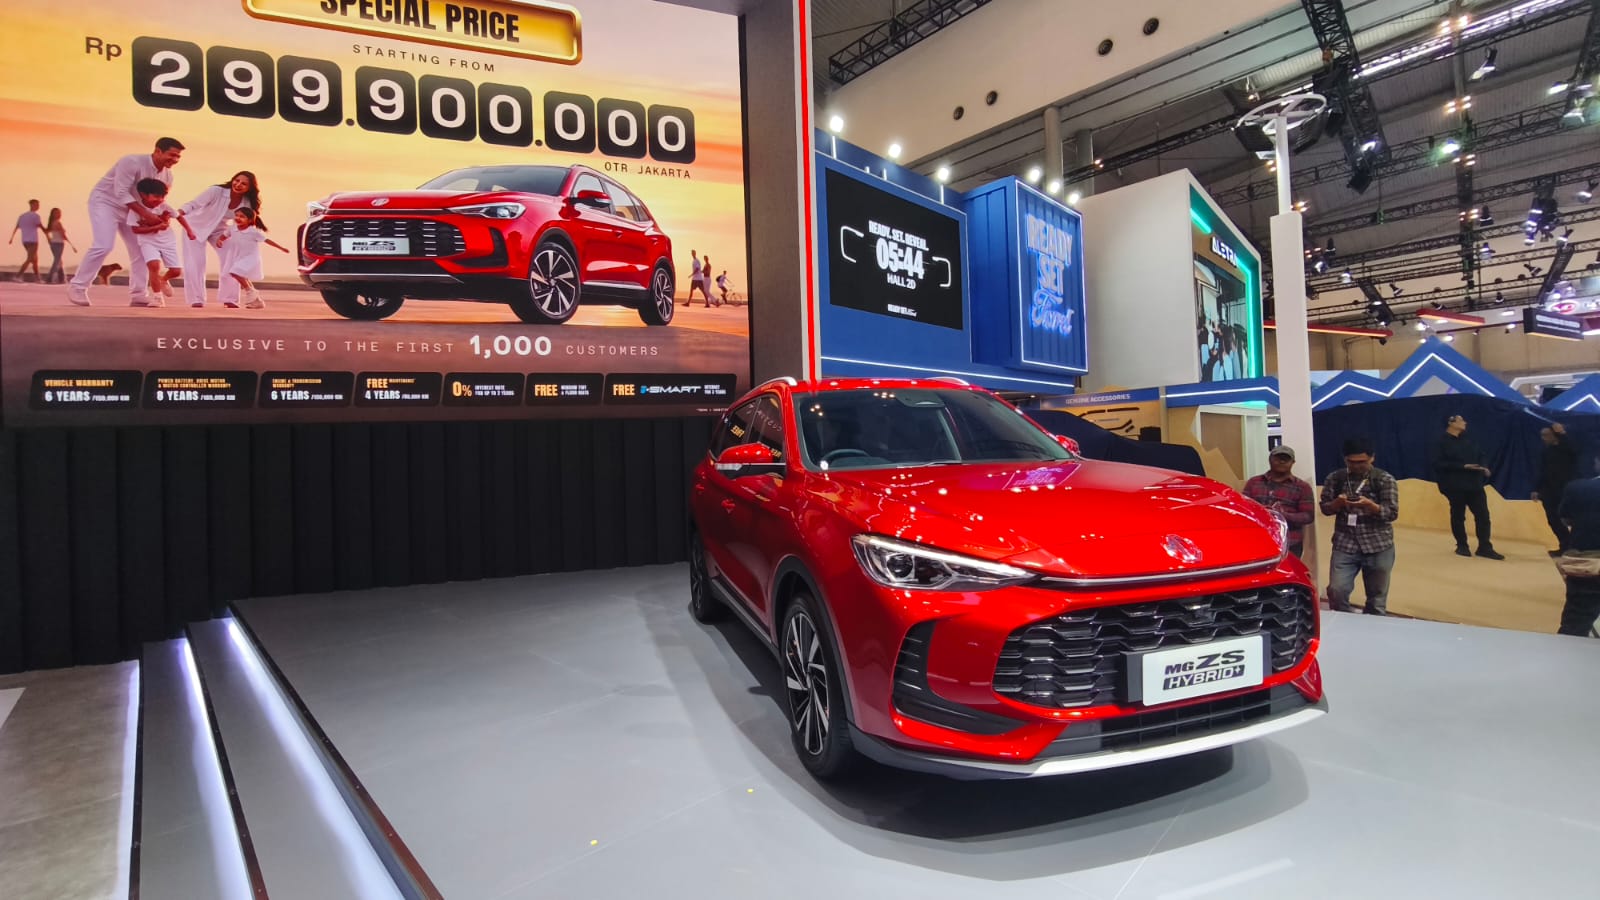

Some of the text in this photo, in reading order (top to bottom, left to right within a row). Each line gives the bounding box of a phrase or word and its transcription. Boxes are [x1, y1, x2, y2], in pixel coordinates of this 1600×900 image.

[446, 4, 520, 42] PRICE
[353, 44, 495, 72] STARTING FROM
[85, 37, 686, 152] Rp 299.900.000
[604, 161, 691, 179] OTR JAKARTA
[1026, 213, 1072, 267] READY
[876, 237, 925, 279] 05:44
[887, 272, 916, 289] HALL 2D
[1038, 253, 1064, 296] SET
[1030, 289, 1074, 334] Ford
[157, 335, 658, 359] EXCLUSIVE TO THE FIRST 1,000 CUSTOMERS
[366, 378, 389, 388] FREE
[452, 381, 473, 397] 0%
[534, 384, 558, 396] FREE
[613, 384, 636, 396] FREE
[45, 390, 53, 402] 6
[56, 390, 90, 402] YEARS
[167, 390, 199, 401] YEARS
[271, 390, 278, 401] 6
[280, 390, 310, 400] YEARS
[365, 390, 371, 399] 4
[373, 390, 401, 399] YEARS
[1090, 393, 1131, 403] ACCESSORIES
[1165, 650, 1245, 676] MG ZS
